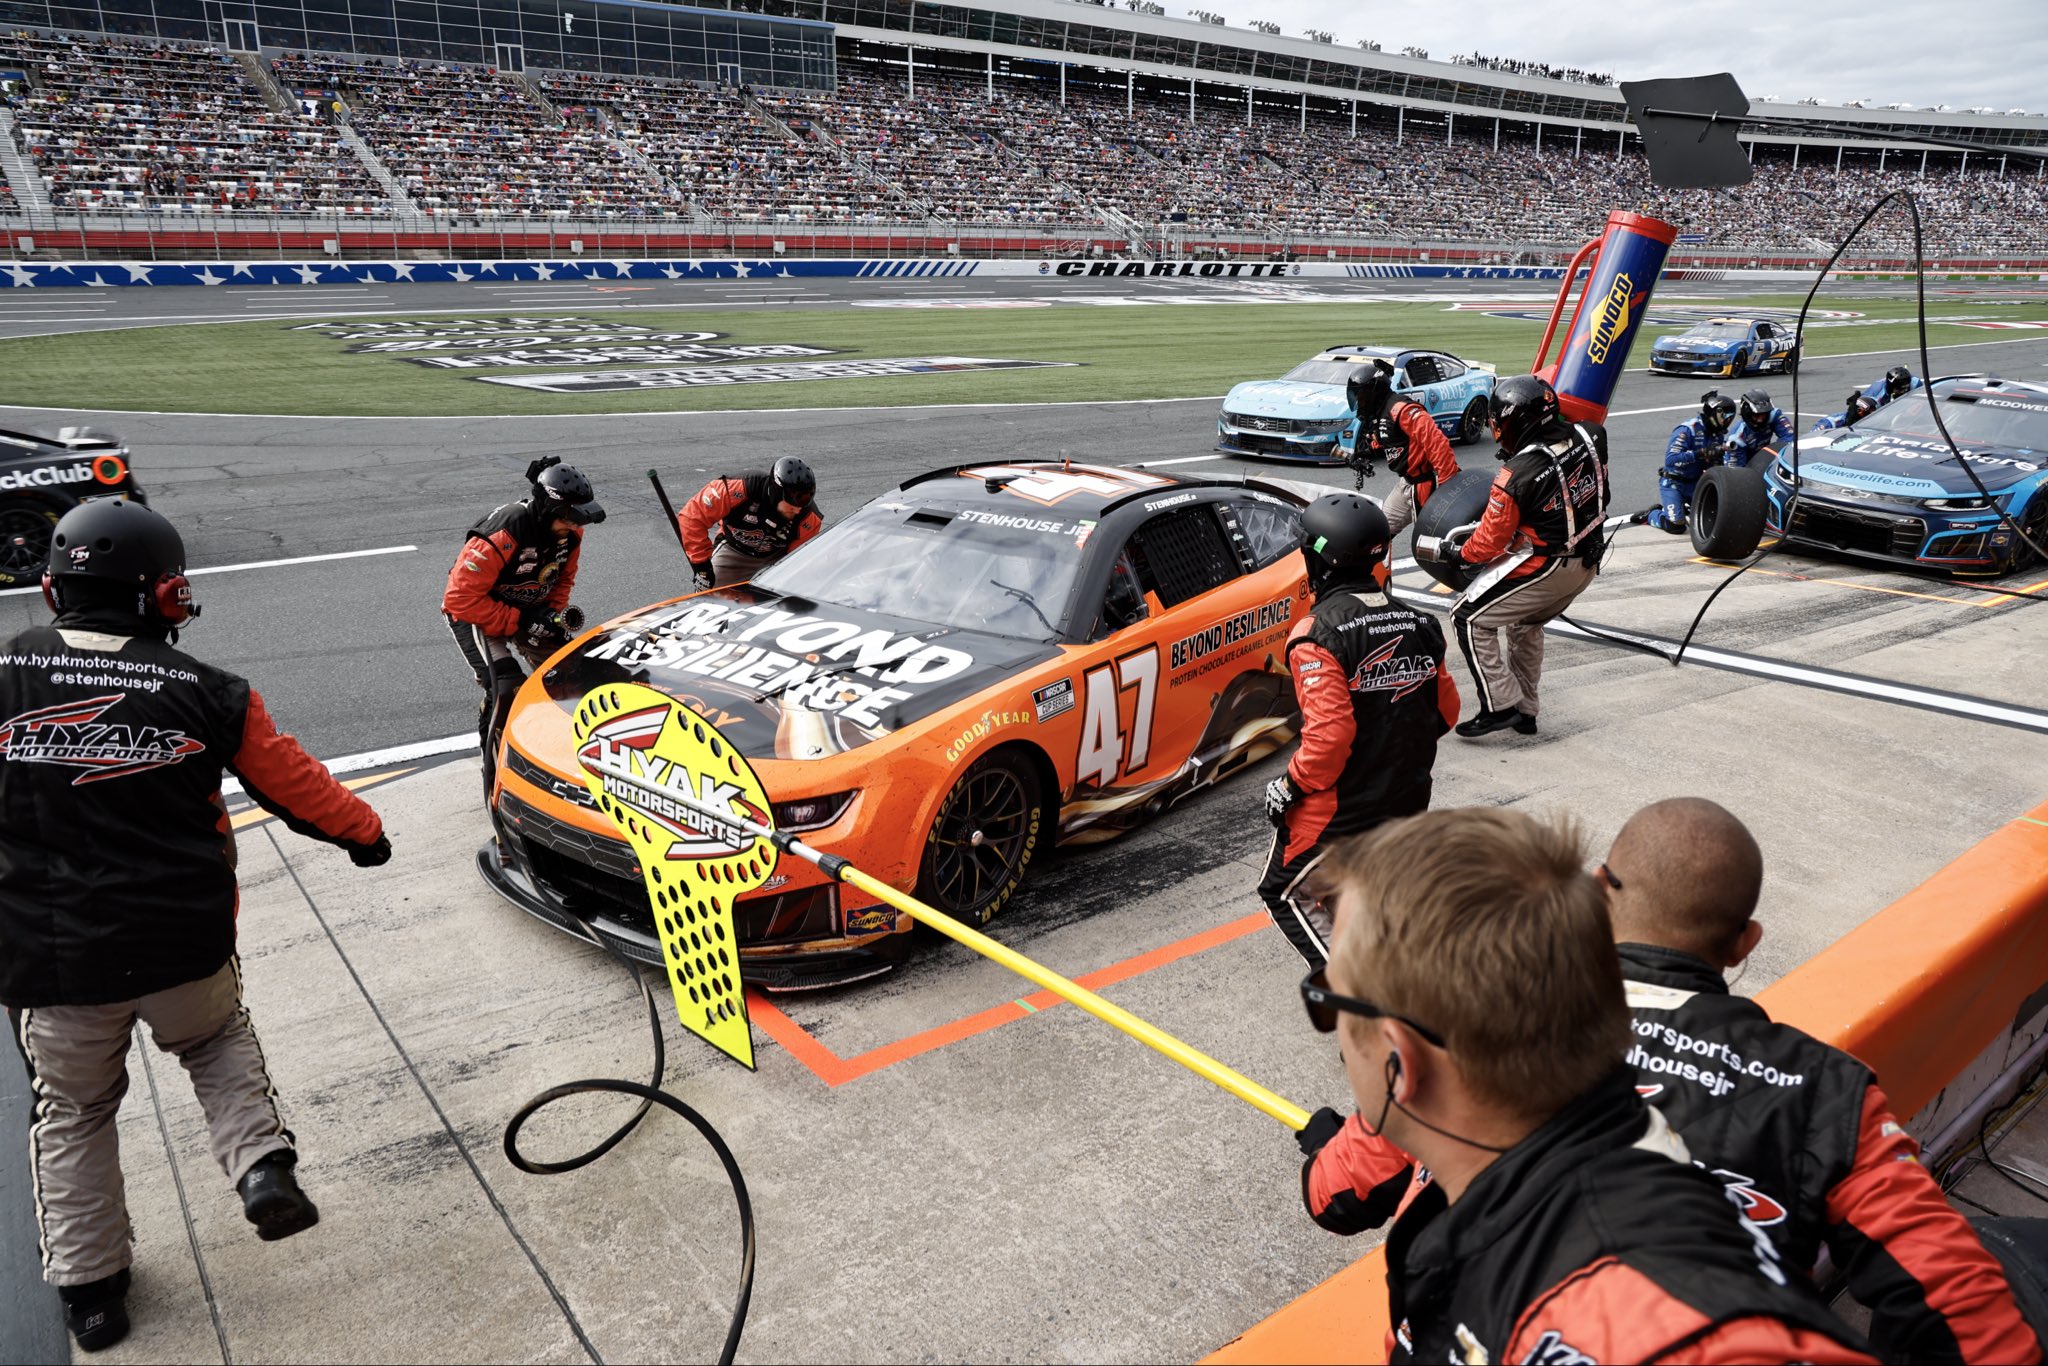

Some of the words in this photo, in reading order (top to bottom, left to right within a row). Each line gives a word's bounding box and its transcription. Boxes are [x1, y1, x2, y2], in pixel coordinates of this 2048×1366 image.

[1056, 262, 1288, 276] CHARLOTTE
[1589, 274, 1632, 364] SUNOCO
[0, 463, 93, 490] ckClub
[1811, 462, 1932, 489] delawarelife.com
[958, 510, 1064, 534] STENHOUSE
[1170, 624, 1223, 671] BEYOND
[1224, 596, 1291, 646] RESILIENCE
[1169, 668, 1198, 690] PROTEIN
[1199, 651, 1236, 677] CHOCOLATE
[1236, 638, 1264, 660] CARAMEL
[1265, 627, 1290, 646] CRUNCH
[1357, 655, 1432, 681] HYAK
[50, 671, 164, 693] @stenhousejr
[1045, 682, 1067, 698] NASCAR
[1052, 694, 1069, 709] SERIES
[1075, 642, 1160, 788] 47
[8, 722, 186, 752] HYAK
[7, 745, 176, 763] MOTORSPORTS
[594, 733, 752, 815] HYAK
[602, 774, 742, 850] MOTORSPORTS
[848, 911, 895, 928] SUNOCO
